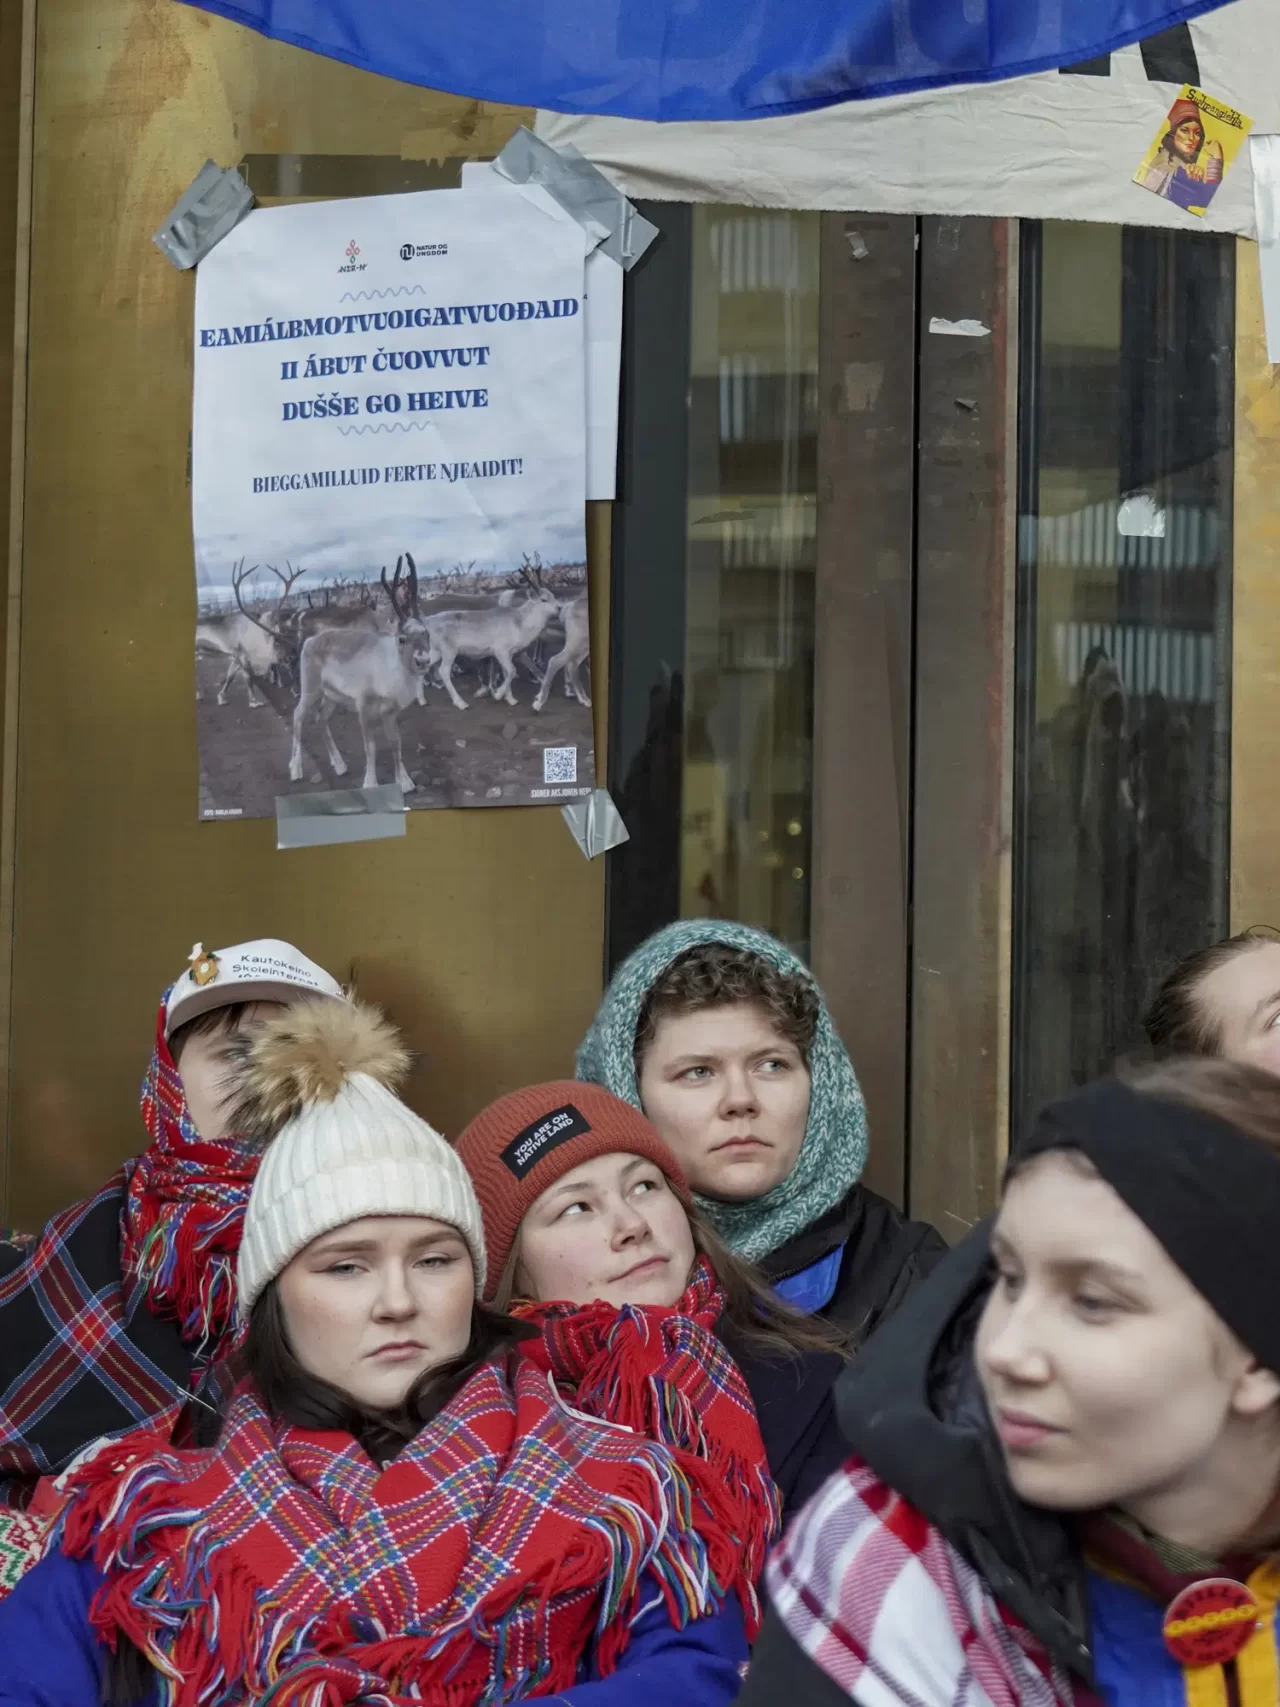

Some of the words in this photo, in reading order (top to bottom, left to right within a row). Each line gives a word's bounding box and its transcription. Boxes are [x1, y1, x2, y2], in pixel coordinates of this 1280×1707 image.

[416, 249, 448, 257] UNGDOM
[200, 298, 579, 348] EAMIÁLBMOTVUOIGATVUOĐAID
[280, 361, 299, 380] II
[303, 353, 367, 379] ÁBUT
[372, 347, 490, 373] ČUOVVUT
[282, 392, 359, 421] DUŠŠE
[366, 393, 401, 414] GO
[407, 389, 489, 412] HEIVE
[252, 466, 381, 493] BIEGGAMILLUID
[384, 463, 437, 483] FERTE
[440, 458, 524, 482] NJEAIDIT!
[531, 789, 550, 798] SIGNER
[551, 788, 578, 797] AKSJONEN
[232, 964, 319, 987] Skoleinternat
[241, 954, 312, 978] Kautokeino
[514, 1138, 533, 1157] YOU
[534, 1122, 553, 1140] ARE
[552, 1112, 569, 1124] ON
[516, 1135, 548, 1166] NATIVE
[547, 1118, 574, 1137] LAND
